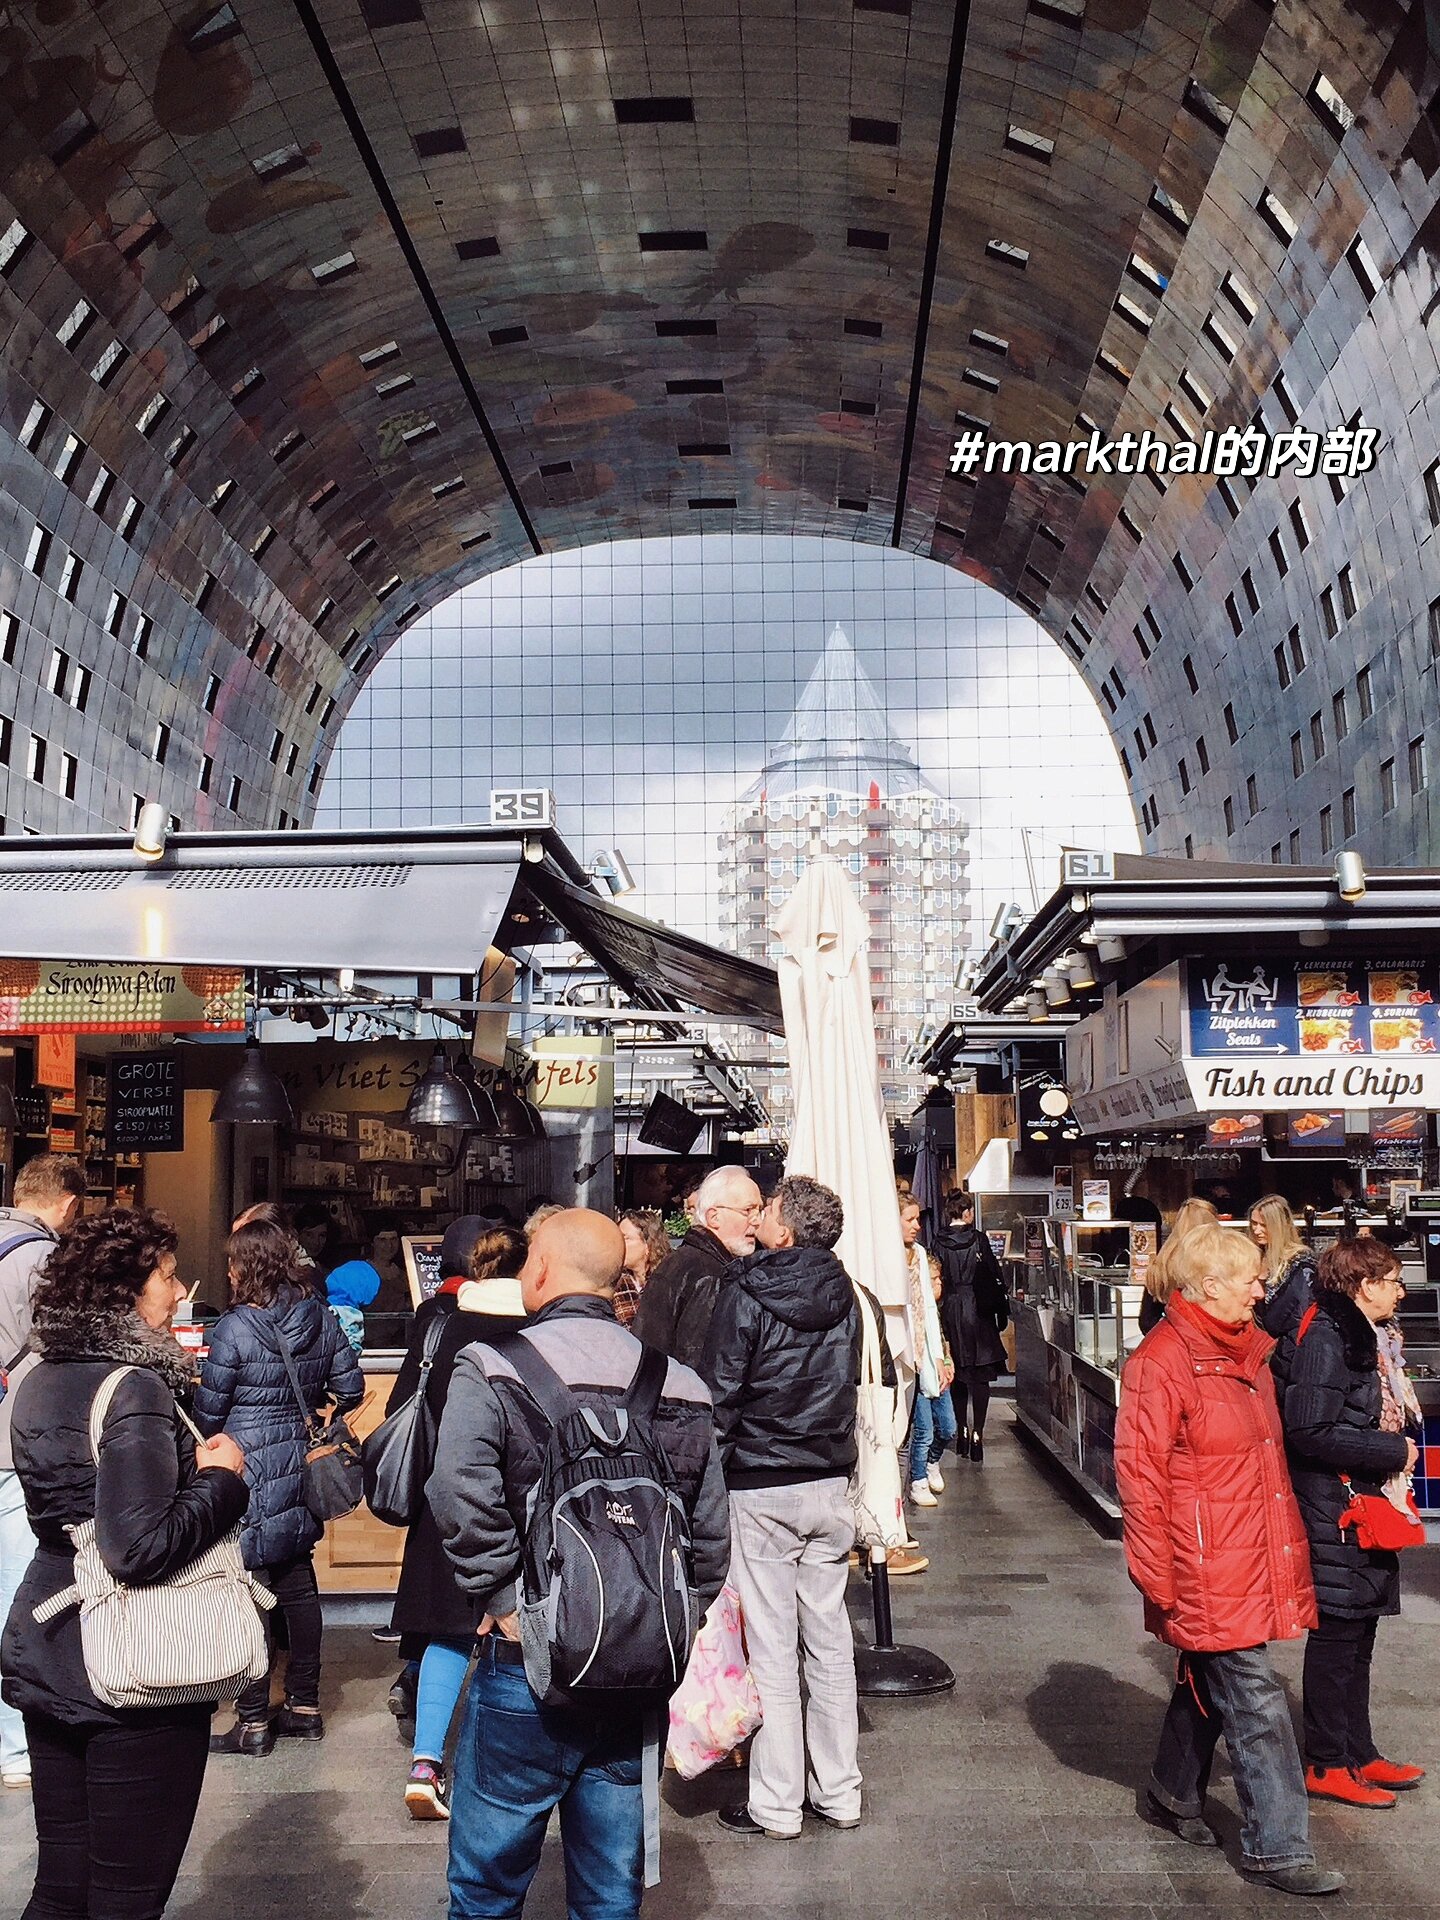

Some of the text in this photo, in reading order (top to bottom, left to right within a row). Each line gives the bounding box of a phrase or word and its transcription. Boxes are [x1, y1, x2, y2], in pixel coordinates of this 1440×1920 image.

[495, 793, 543, 820] 39
[1069, 855, 1110, 876] 61
[1375, 959, 1426, 969] CALAMARIS
[953, 1005, 976, 1018] 65
[1209, 1016, 1276, 1030] Zitplekken
[1226, 1033, 1261, 1047] Seats
[118, 1062, 175, 1080] GROTE
[313, 1061, 391, 1090] Vliet
[1204, 1067, 1265, 1097] Fish
[1273, 1068, 1336, 1096] and
[1343, 1065, 1424, 1105] Chips
[118, 1086, 173, 1099] VERSE
[1230, 1135, 1262, 1146] Paling
[1374, 1137, 1424, 1145] Makreel
